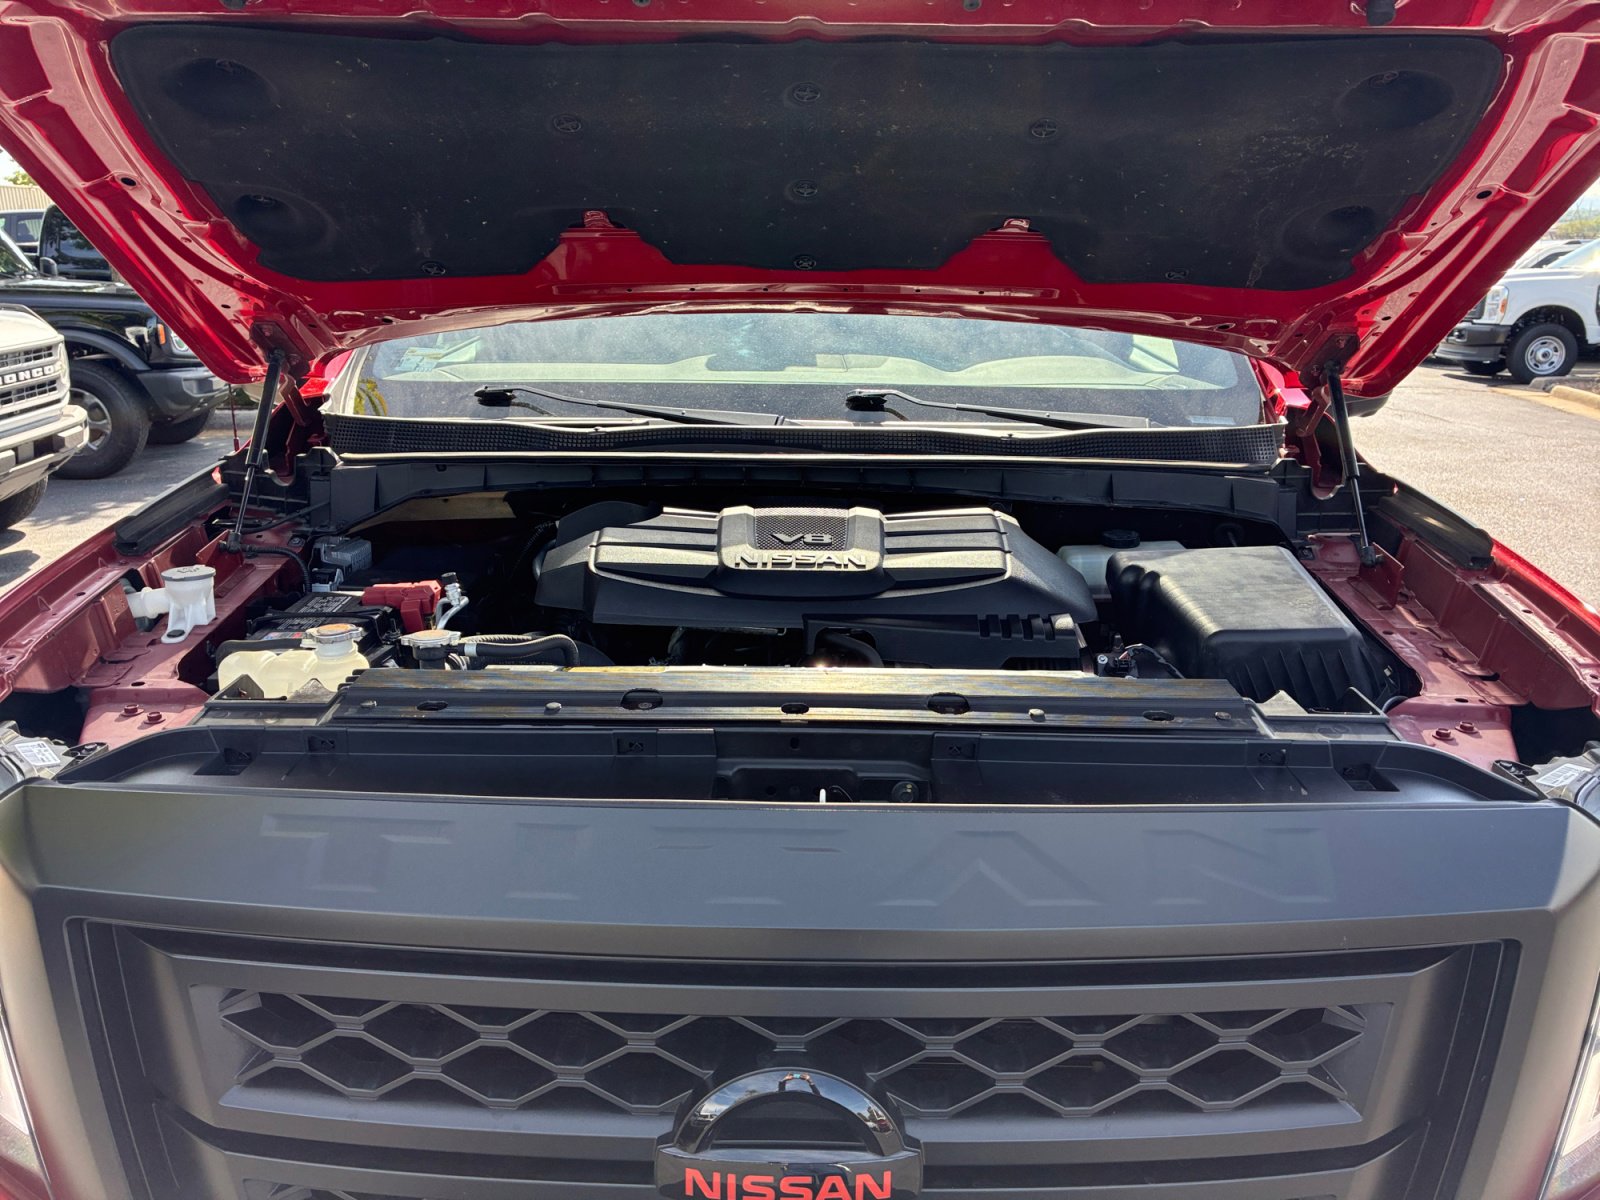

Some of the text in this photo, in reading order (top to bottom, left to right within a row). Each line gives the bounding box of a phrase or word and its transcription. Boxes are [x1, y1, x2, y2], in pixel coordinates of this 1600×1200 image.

[0, 365, 54, 386] ONCO
[769, 532, 833, 546] V8
[734, 551, 867, 569] NISSAN
[260, 813, 1336, 907] TITAN
[684, 1167, 892, 1200] NISSAN
